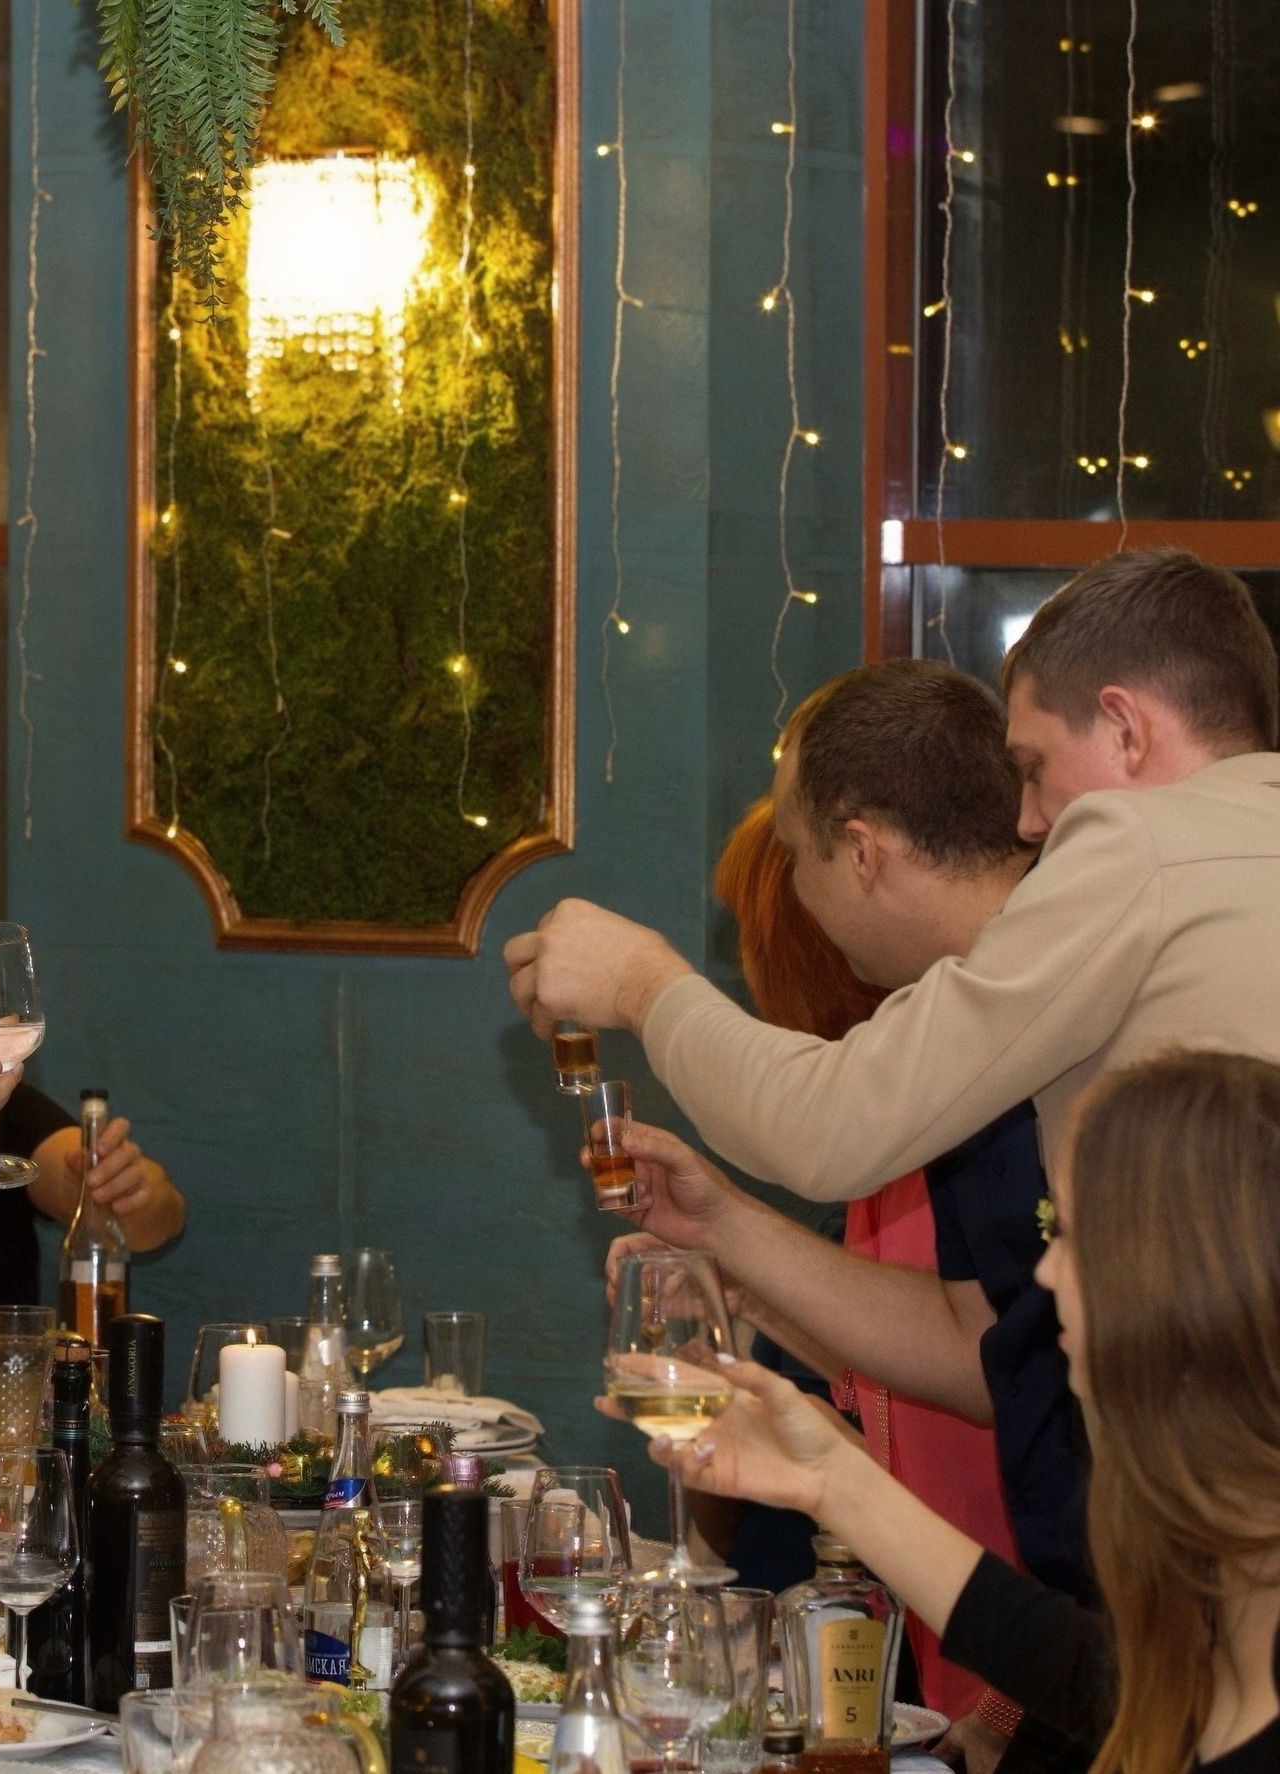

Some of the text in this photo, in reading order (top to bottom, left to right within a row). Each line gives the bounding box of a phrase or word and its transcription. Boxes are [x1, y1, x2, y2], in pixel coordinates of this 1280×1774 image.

[126, 1339, 137, 1397] FANAGORIA
[828, 1668, 874, 1682] ANRI
[845, 1706, 857, 1722] 5
